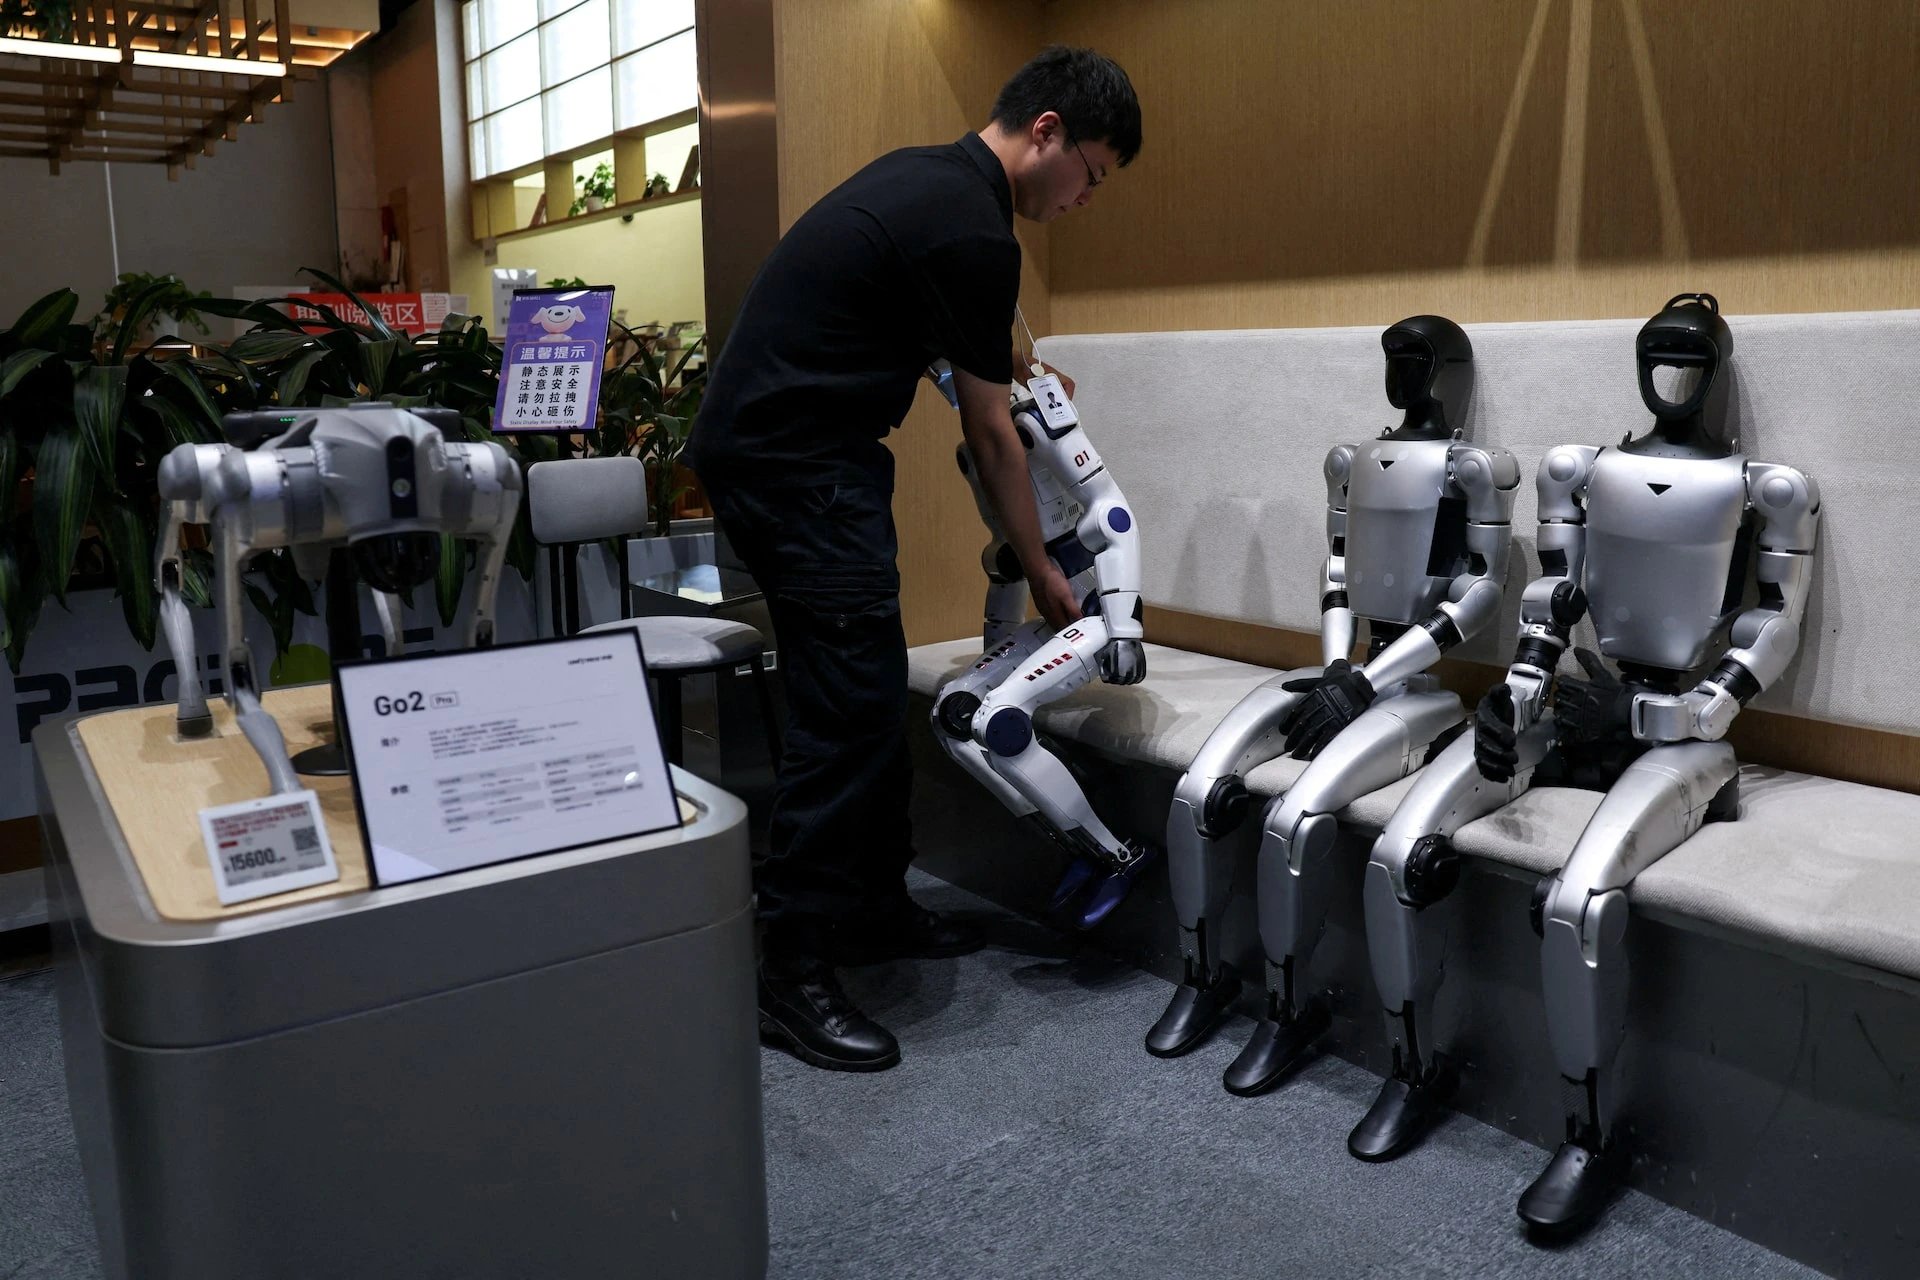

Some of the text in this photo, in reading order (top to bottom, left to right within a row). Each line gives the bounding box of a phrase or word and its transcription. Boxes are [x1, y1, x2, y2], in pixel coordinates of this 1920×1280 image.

[520, 345, 586, 360] 温馨提示
[521, 365, 580, 377] 静态展示
[519, 378, 578, 391] 注意安全
[517, 391, 577, 404] 请勿拉拽
[515, 405, 575, 418] 小心砸伤
[1074, 449, 1090, 468] 01
[374, 690, 426, 717] Go2
